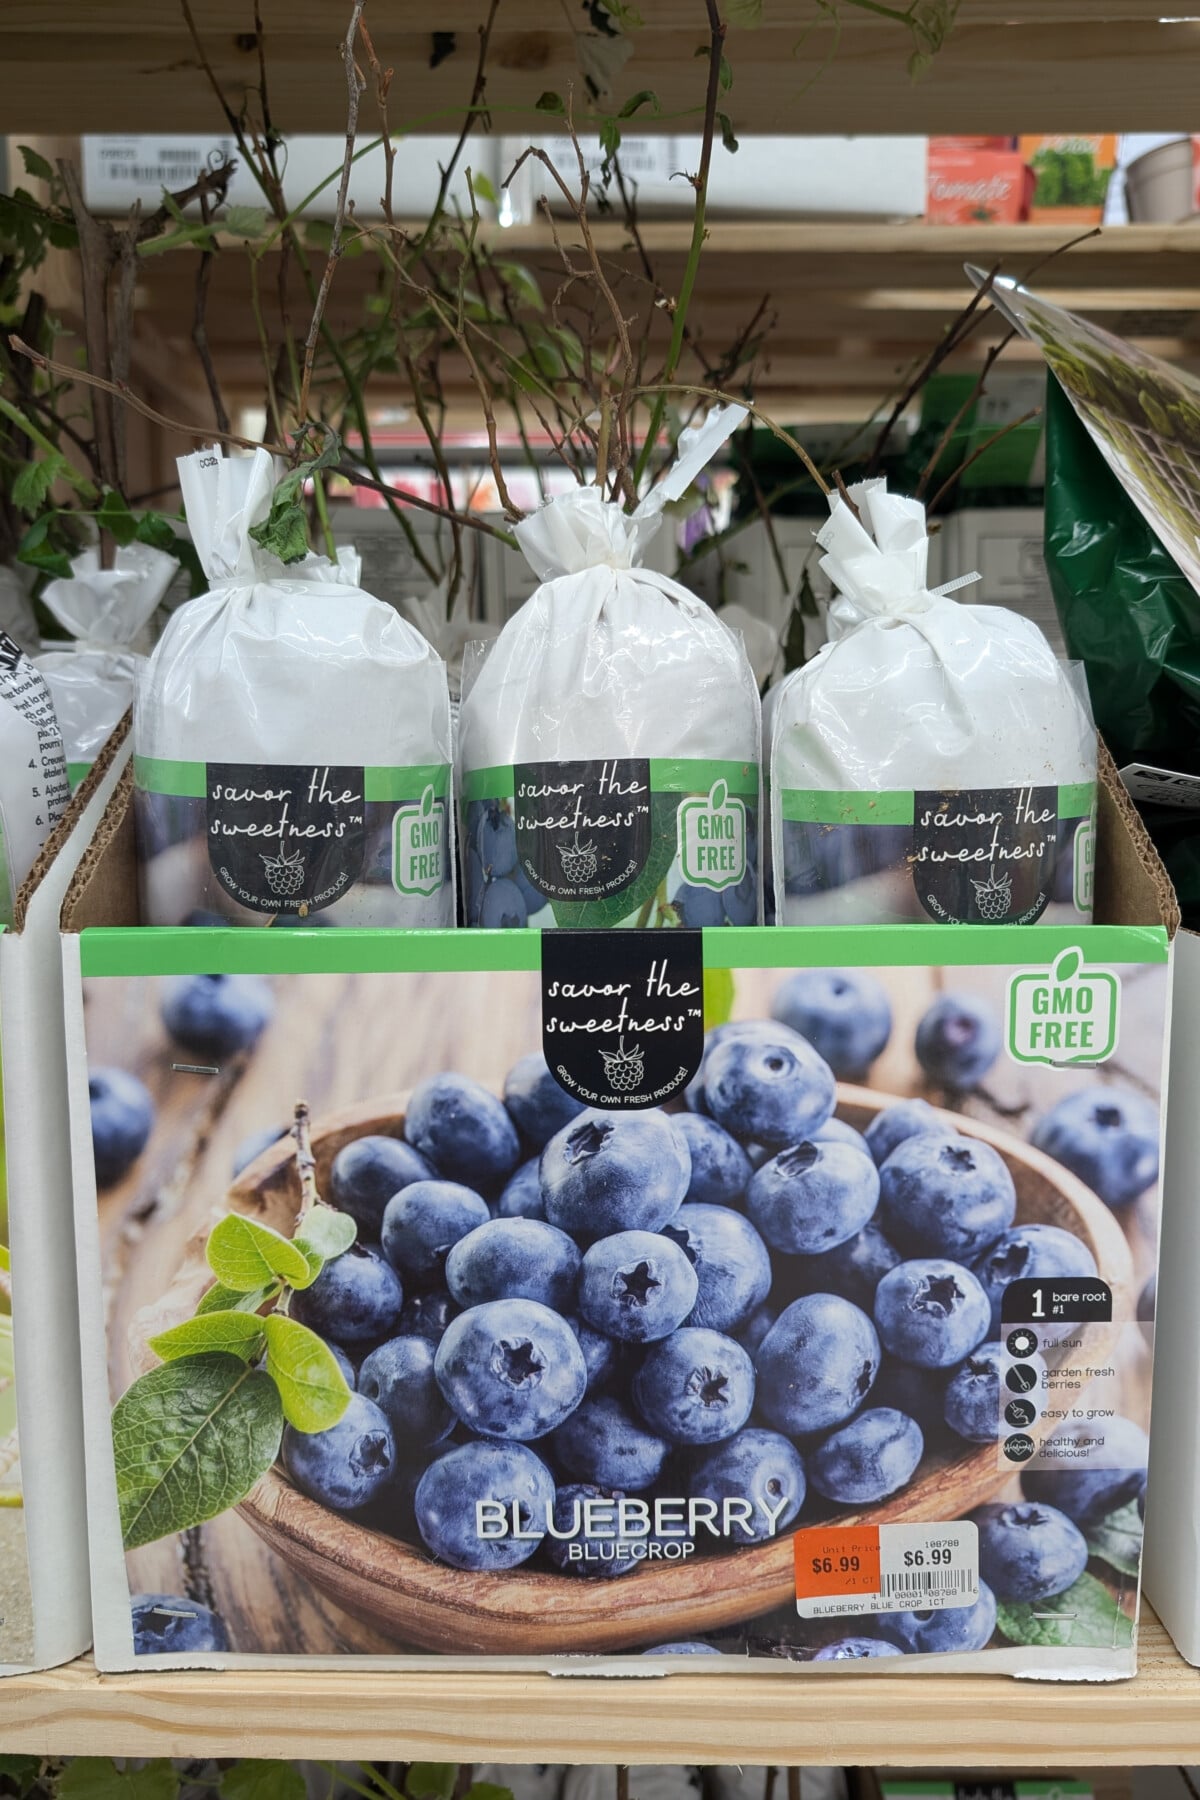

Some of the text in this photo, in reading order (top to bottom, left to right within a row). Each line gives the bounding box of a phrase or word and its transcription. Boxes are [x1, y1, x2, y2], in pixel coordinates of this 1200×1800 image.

[28, 759, 37, 769] 4.
[212, 767, 361, 804] savor the
[518, 760, 648, 798] savor the
[32, 787, 40, 797] 5.
[920, 786, 1056, 828] savor the
[35, 815, 44, 825] 6.
[697, 814, 735, 841] GMO
[410, 821, 439, 849] GMO
[409, 852, 440, 881] FREE
[697, 845, 736, 871] FREE
[524, 859, 638, 895] GROW YOUR OWN FRESH PRODUCE!
[219, 866, 239, 890] GROW
[238, 888, 258, 905] YOUR
[261, 898, 282, 908] OWN
[314, 871, 350, 903] PRODUCE!
[927, 894, 947, 917] GROW
[548, 959, 699, 997] savor the
[1032, 987, 1093, 1015] GMO
[1030, 1021, 1094, 1049] FREE
[557, 1064, 689, 1104] GROW YOUR OWN FRESH PRODUCE!
[1031, 1288, 1046, 1317] 1
[1052, 1292, 1107, 1302] bare root
[1052, 1305, 1064, 1315] #1
[1042, 1338, 1082, 1348] full sun
[1041, 1367, 1115, 1379] garden fresh
[1041, 1380, 1081, 1390] berries
[1040, 1408, 1115, 1421] easy to grow
[1039, 1437, 1105, 1448] healthy and
[1039, 1449, 1090, 1459] delicious!
[475, 1497, 789, 1540] BLUEBERRY
[569, 1542, 695, 1561] BLUECROP
[822, 1544, 881, 1554] Unit Price
[925, 1540, 960, 1549] 108788
[812, 1556, 860, 1575] $6.99
[903, 1549, 952, 1567] $6.99
[862, 1576, 873, 1584] CT
[894, 1591, 922, 1599] 00001
[928, 1588, 957, 1598] 08788
[813, 1598, 945, 1615] BLUEBERRY BLUE CROP 1CT
